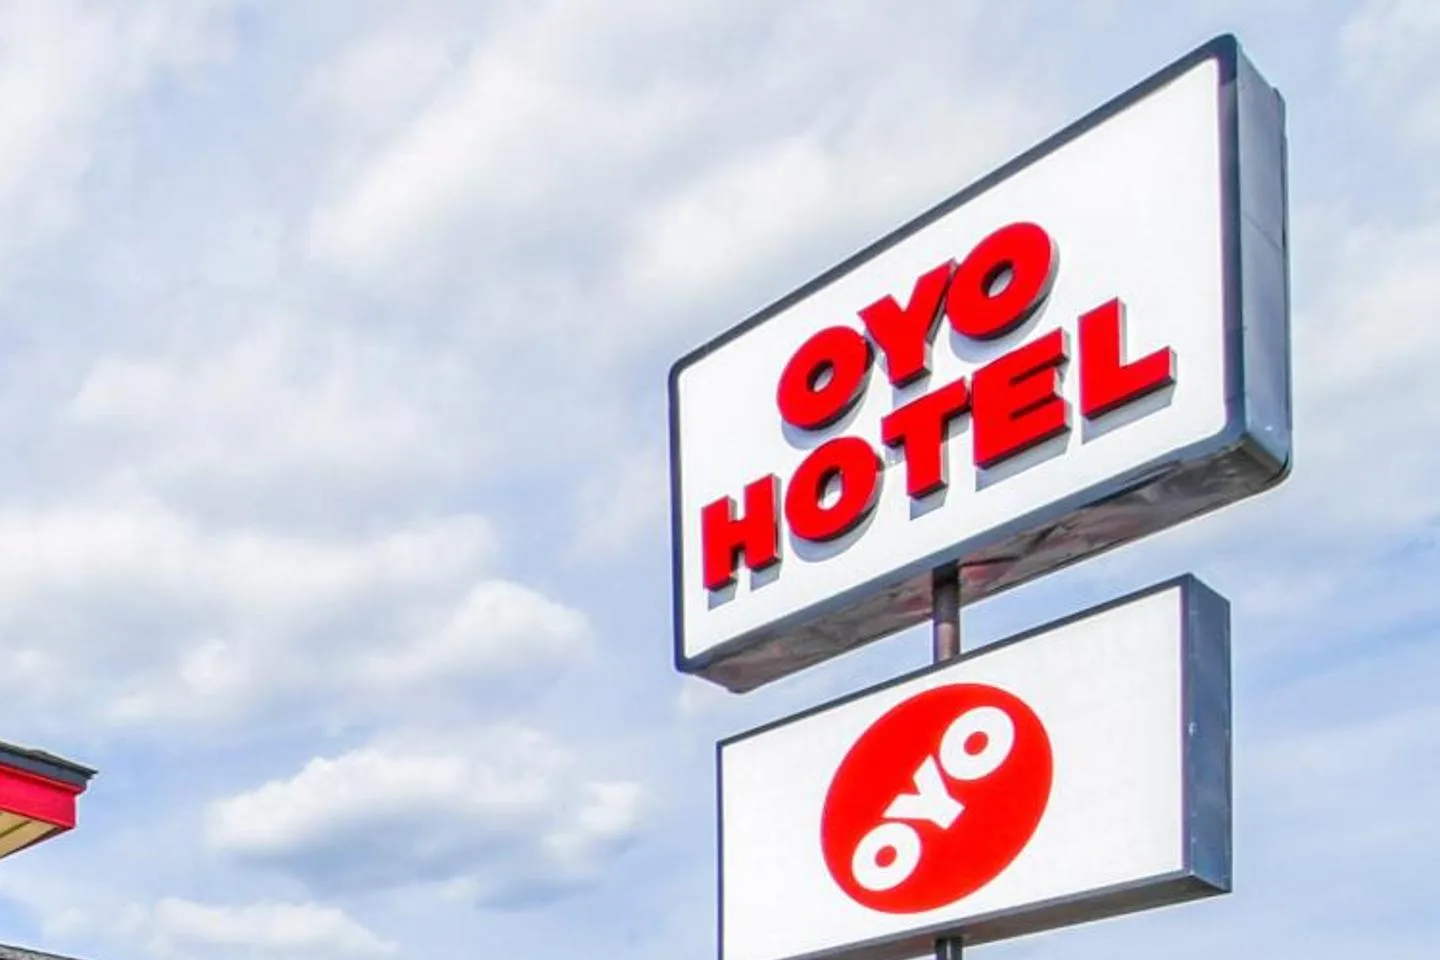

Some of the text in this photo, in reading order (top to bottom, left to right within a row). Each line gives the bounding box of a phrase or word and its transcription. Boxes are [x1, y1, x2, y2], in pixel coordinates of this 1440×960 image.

[776, 222, 1057, 431] OYO
[702, 297, 1176, 592] HOTEL
[851, 706, 1014, 891] OYO
